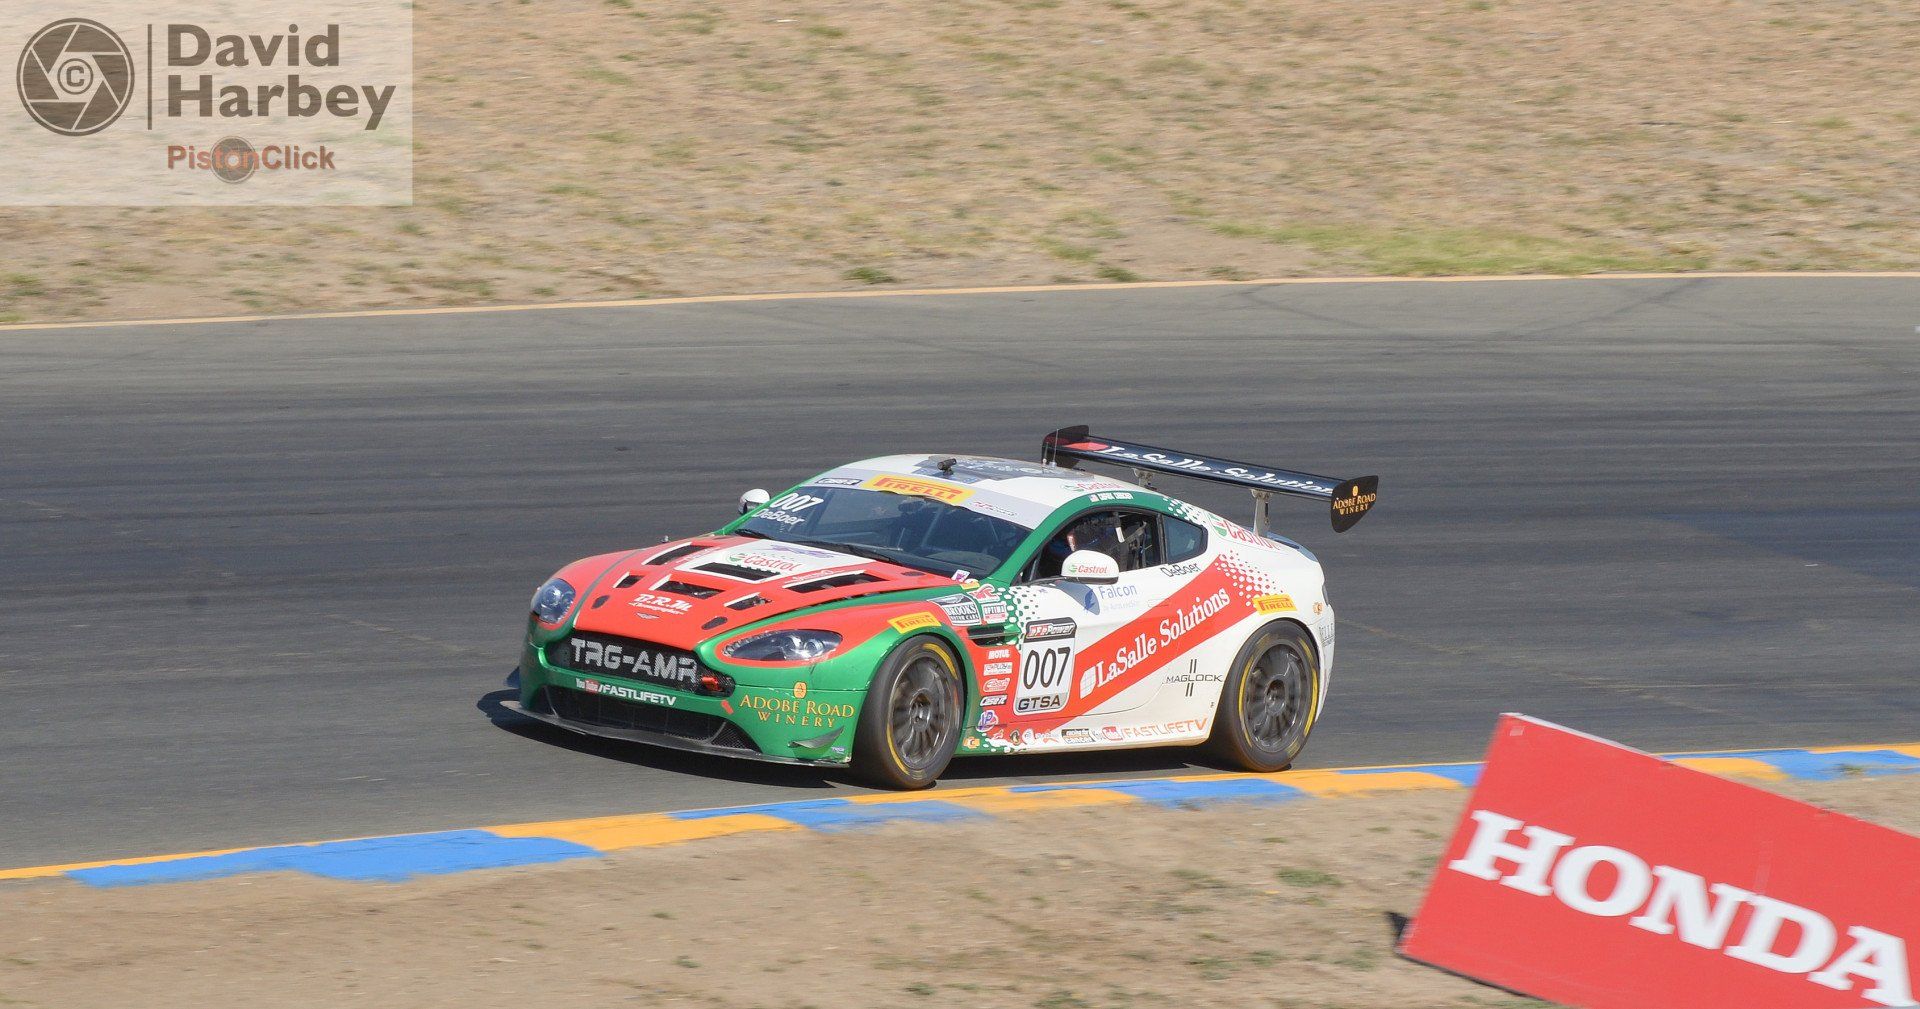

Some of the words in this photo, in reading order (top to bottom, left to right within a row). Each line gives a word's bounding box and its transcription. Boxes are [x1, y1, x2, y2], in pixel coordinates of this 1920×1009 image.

[873, 477, 964, 500] PIRELLI
[770, 492, 824, 513] 007
[1333, 497, 1356, 510] ADOBE
[1357, 493, 1376, 505] ROAD
[1340, 503, 1369, 515] WINERY
[752, 508, 805, 525] DeBoer
[744, 552, 803, 572] Castrol
[1077, 564, 1108, 574] Castrol
[1160, 562, 1201, 577] DeBoer
[1098, 584, 1138, 600] Falcon
[944, 603, 978, 616] BROOKS
[1258, 597, 1294, 611] PIRELLI
[896, 615, 935, 629] PIRELLI
[1095, 632, 1157, 688] LaSalle
[1158, 587, 1231, 648] Solutions
[571, 637, 698, 684] TRG-AMR
[988, 649, 1010, 660] MOTUL
[1023, 646, 1071, 690] 007
[1166, 674, 1223, 684] MAGLOCK
[740, 694, 800, 713] ADOBE
[806, 700, 855, 718] ROAD
[1018, 694, 1061, 711] GTSA
[757, 711, 835, 728] WINERY
[1449, 809, 1918, 1009] HONDA
